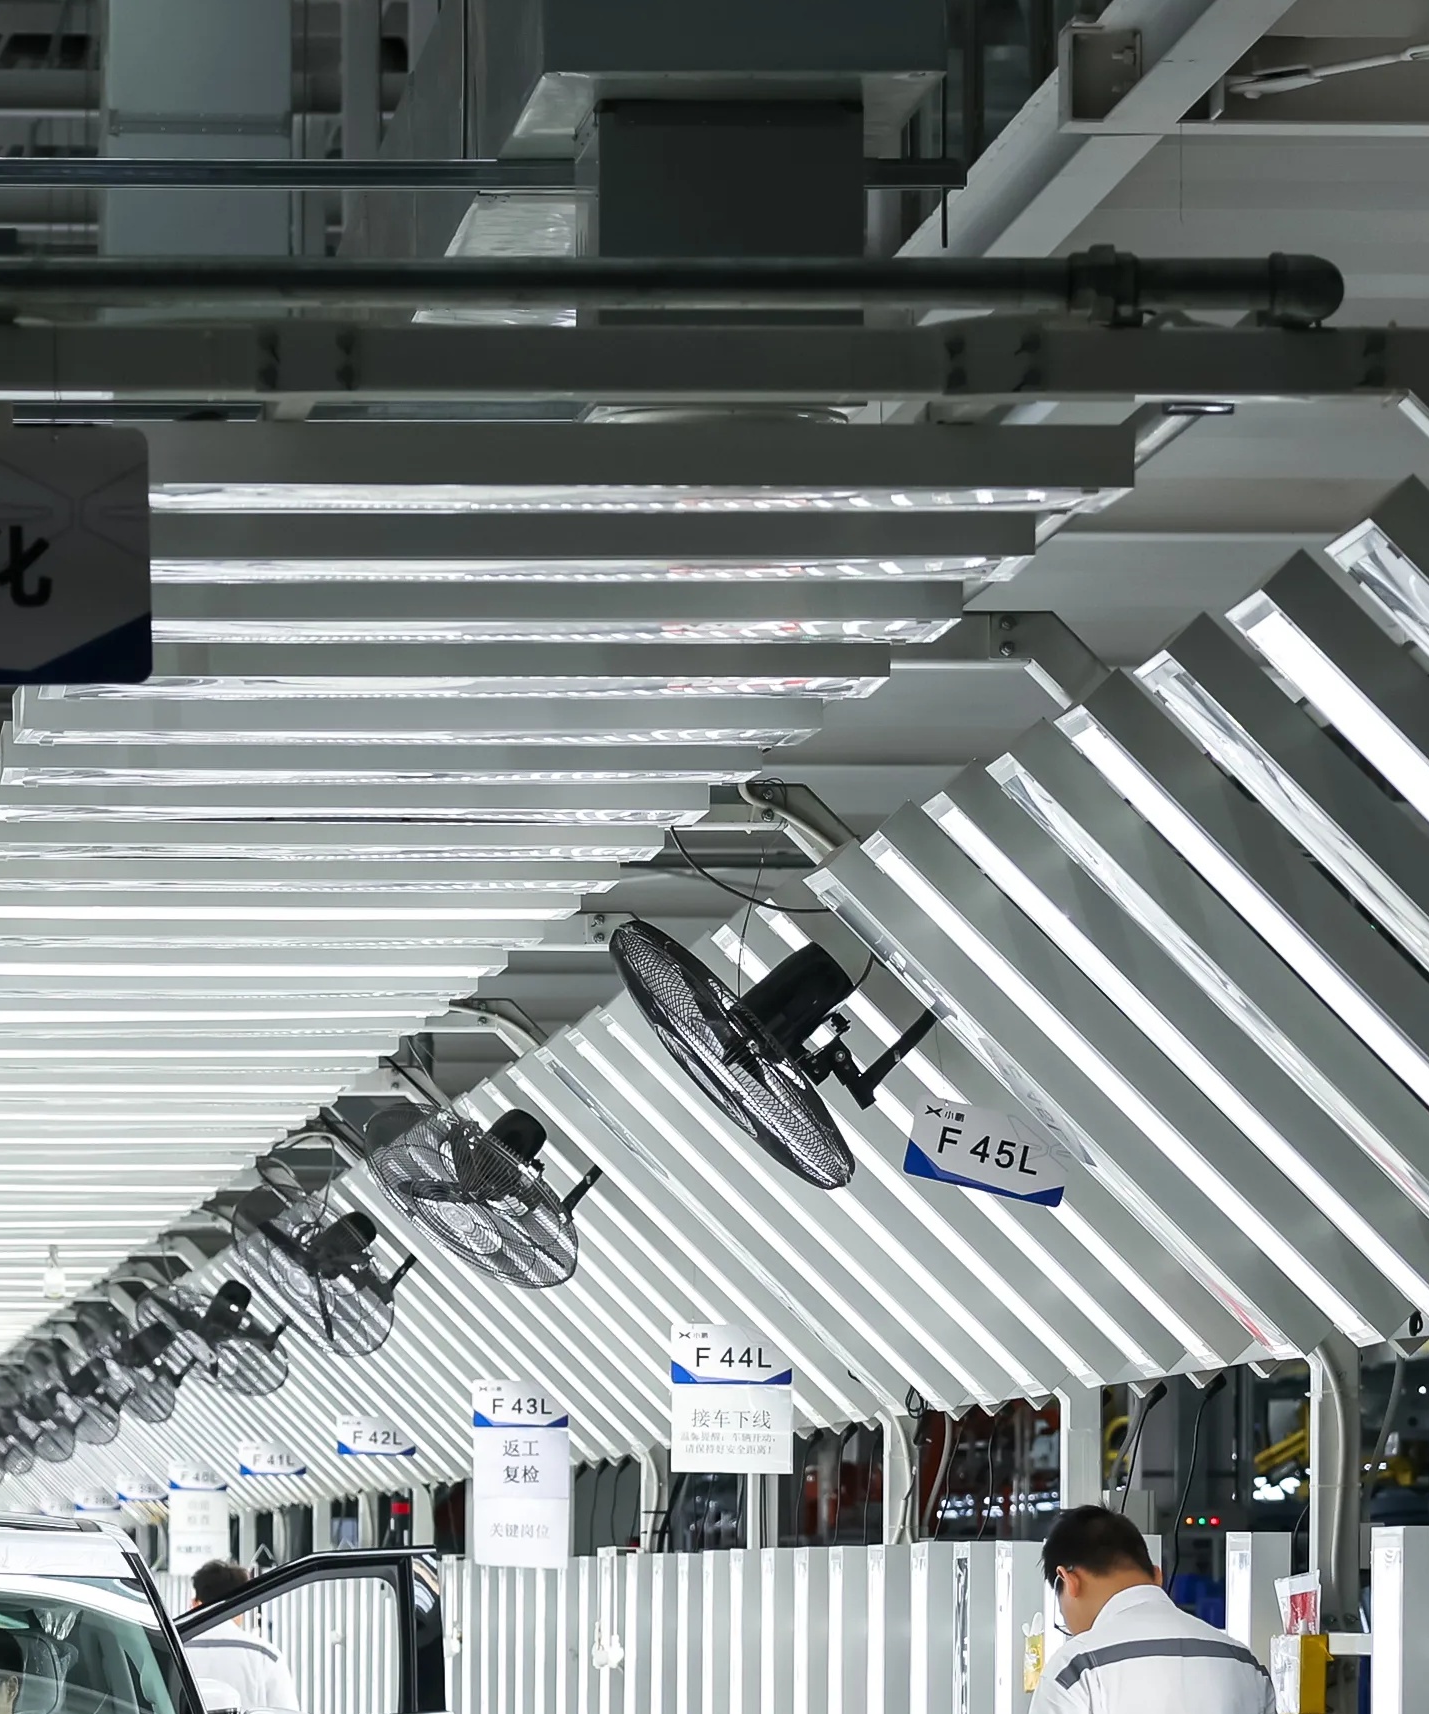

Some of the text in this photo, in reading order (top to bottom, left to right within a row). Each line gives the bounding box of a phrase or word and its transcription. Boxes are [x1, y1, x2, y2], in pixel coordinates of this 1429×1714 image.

[937, 1126, 1038, 1176] F 45L
[696, 1346, 772, 1369] F 44L
[492, 1397, 553, 1415] F 43L
[690, 1408, 772, 1430] 接车下线
[352, 1430, 403, 1446] F 42L
[502, 1439, 540, 1457] 返工
[253, 1453, 296, 1466] F 41L
[502, 1465, 540, 1484] 复检
[490, 1522, 550, 1539] 关键岗位
